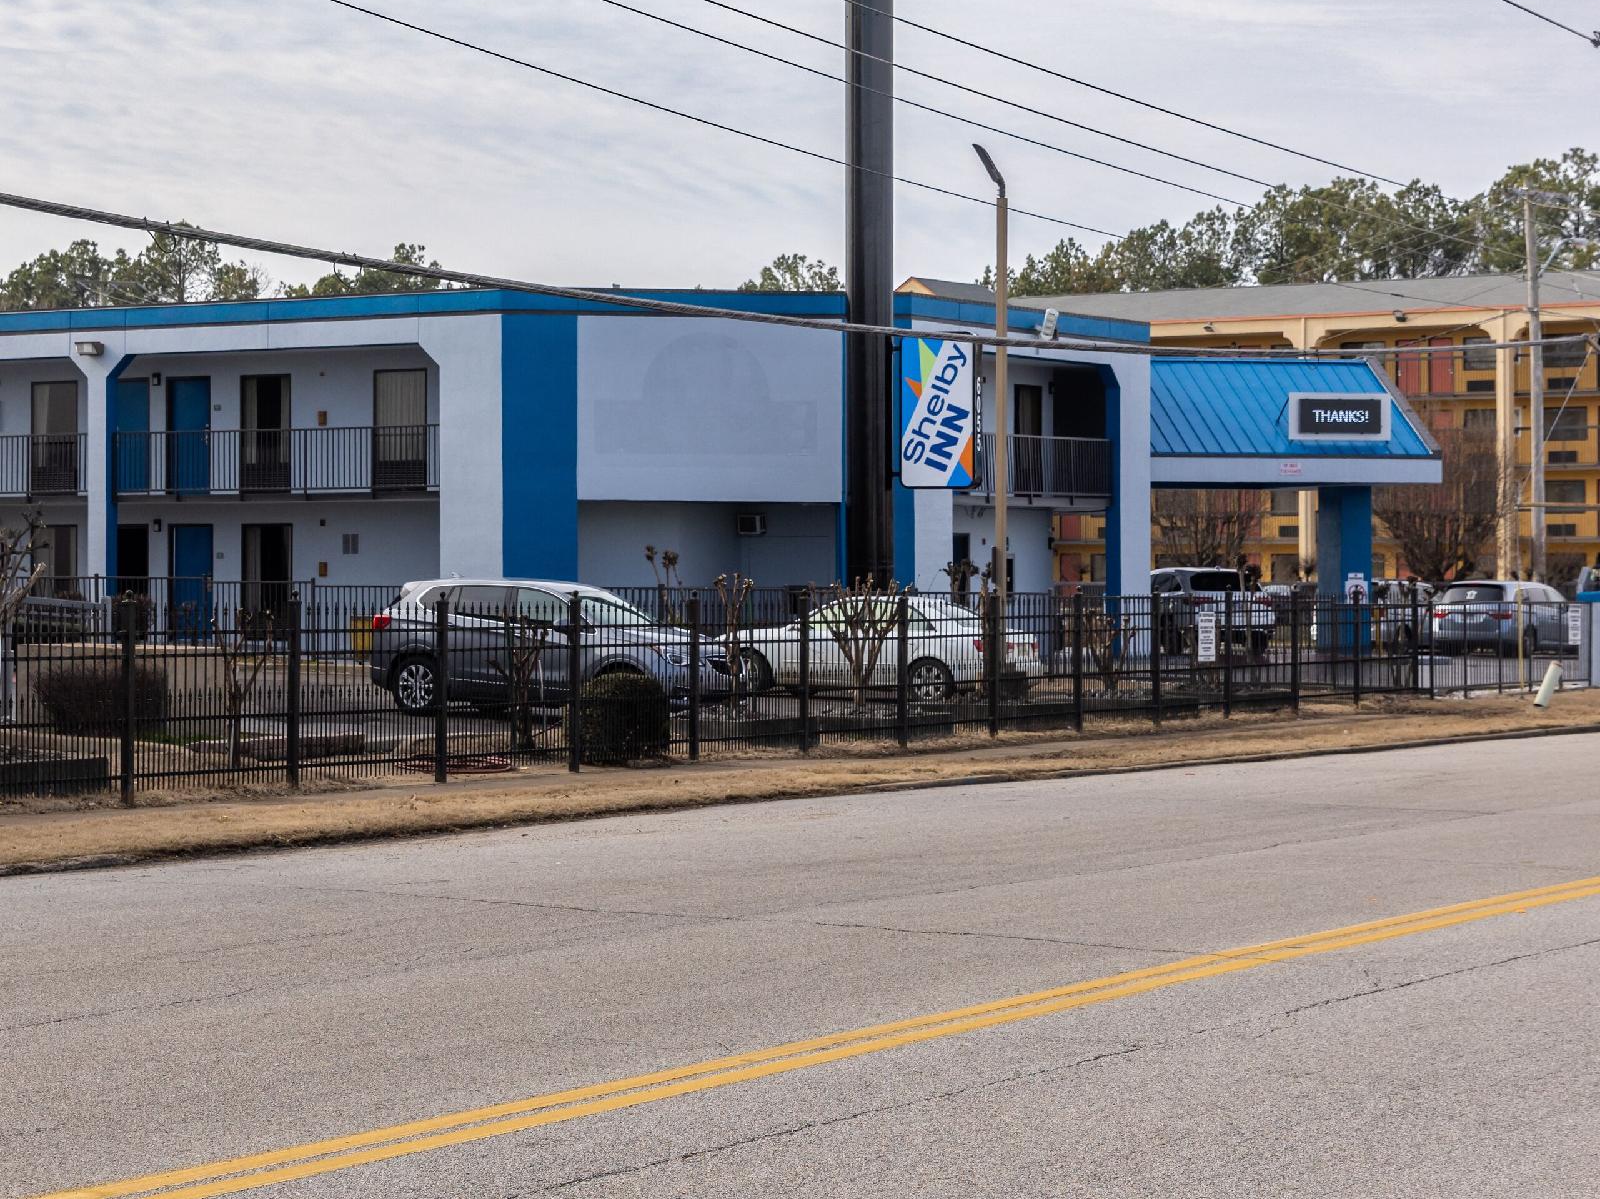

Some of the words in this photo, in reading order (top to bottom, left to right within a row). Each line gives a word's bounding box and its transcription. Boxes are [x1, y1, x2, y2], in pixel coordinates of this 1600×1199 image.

[903, 343, 967, 465] Shelby
[924, 403, 970, 472] INN
[1312, 409, 1369, 423] THANKS!
